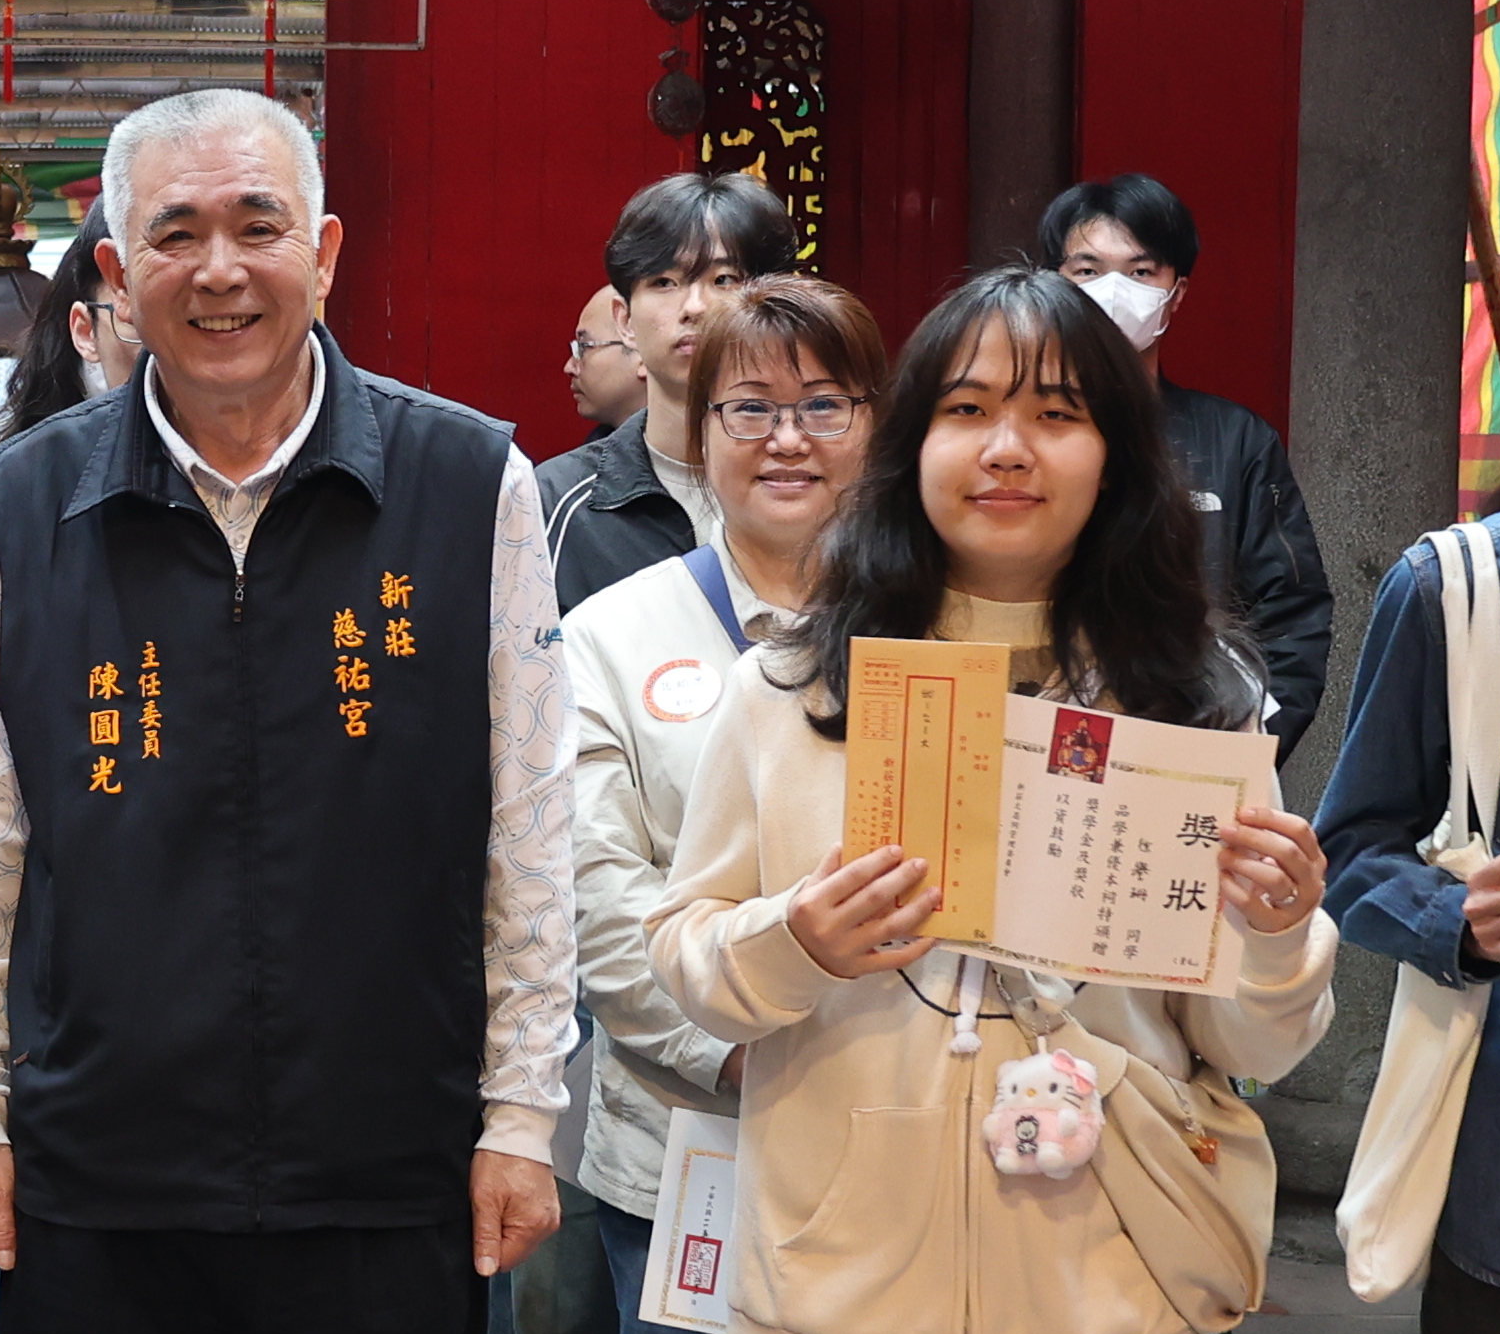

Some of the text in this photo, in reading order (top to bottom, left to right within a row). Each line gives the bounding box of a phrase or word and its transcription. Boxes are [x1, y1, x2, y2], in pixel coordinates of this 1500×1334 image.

[333, 607, 372, 738] 慈祐宮
[380, 571, 417, 657] 新莊
[89, 661, 125, 794] 陳圓光
[138, 641, 162, 759] 主任委員
[1163, 813, 1220, 911] 獎狀
